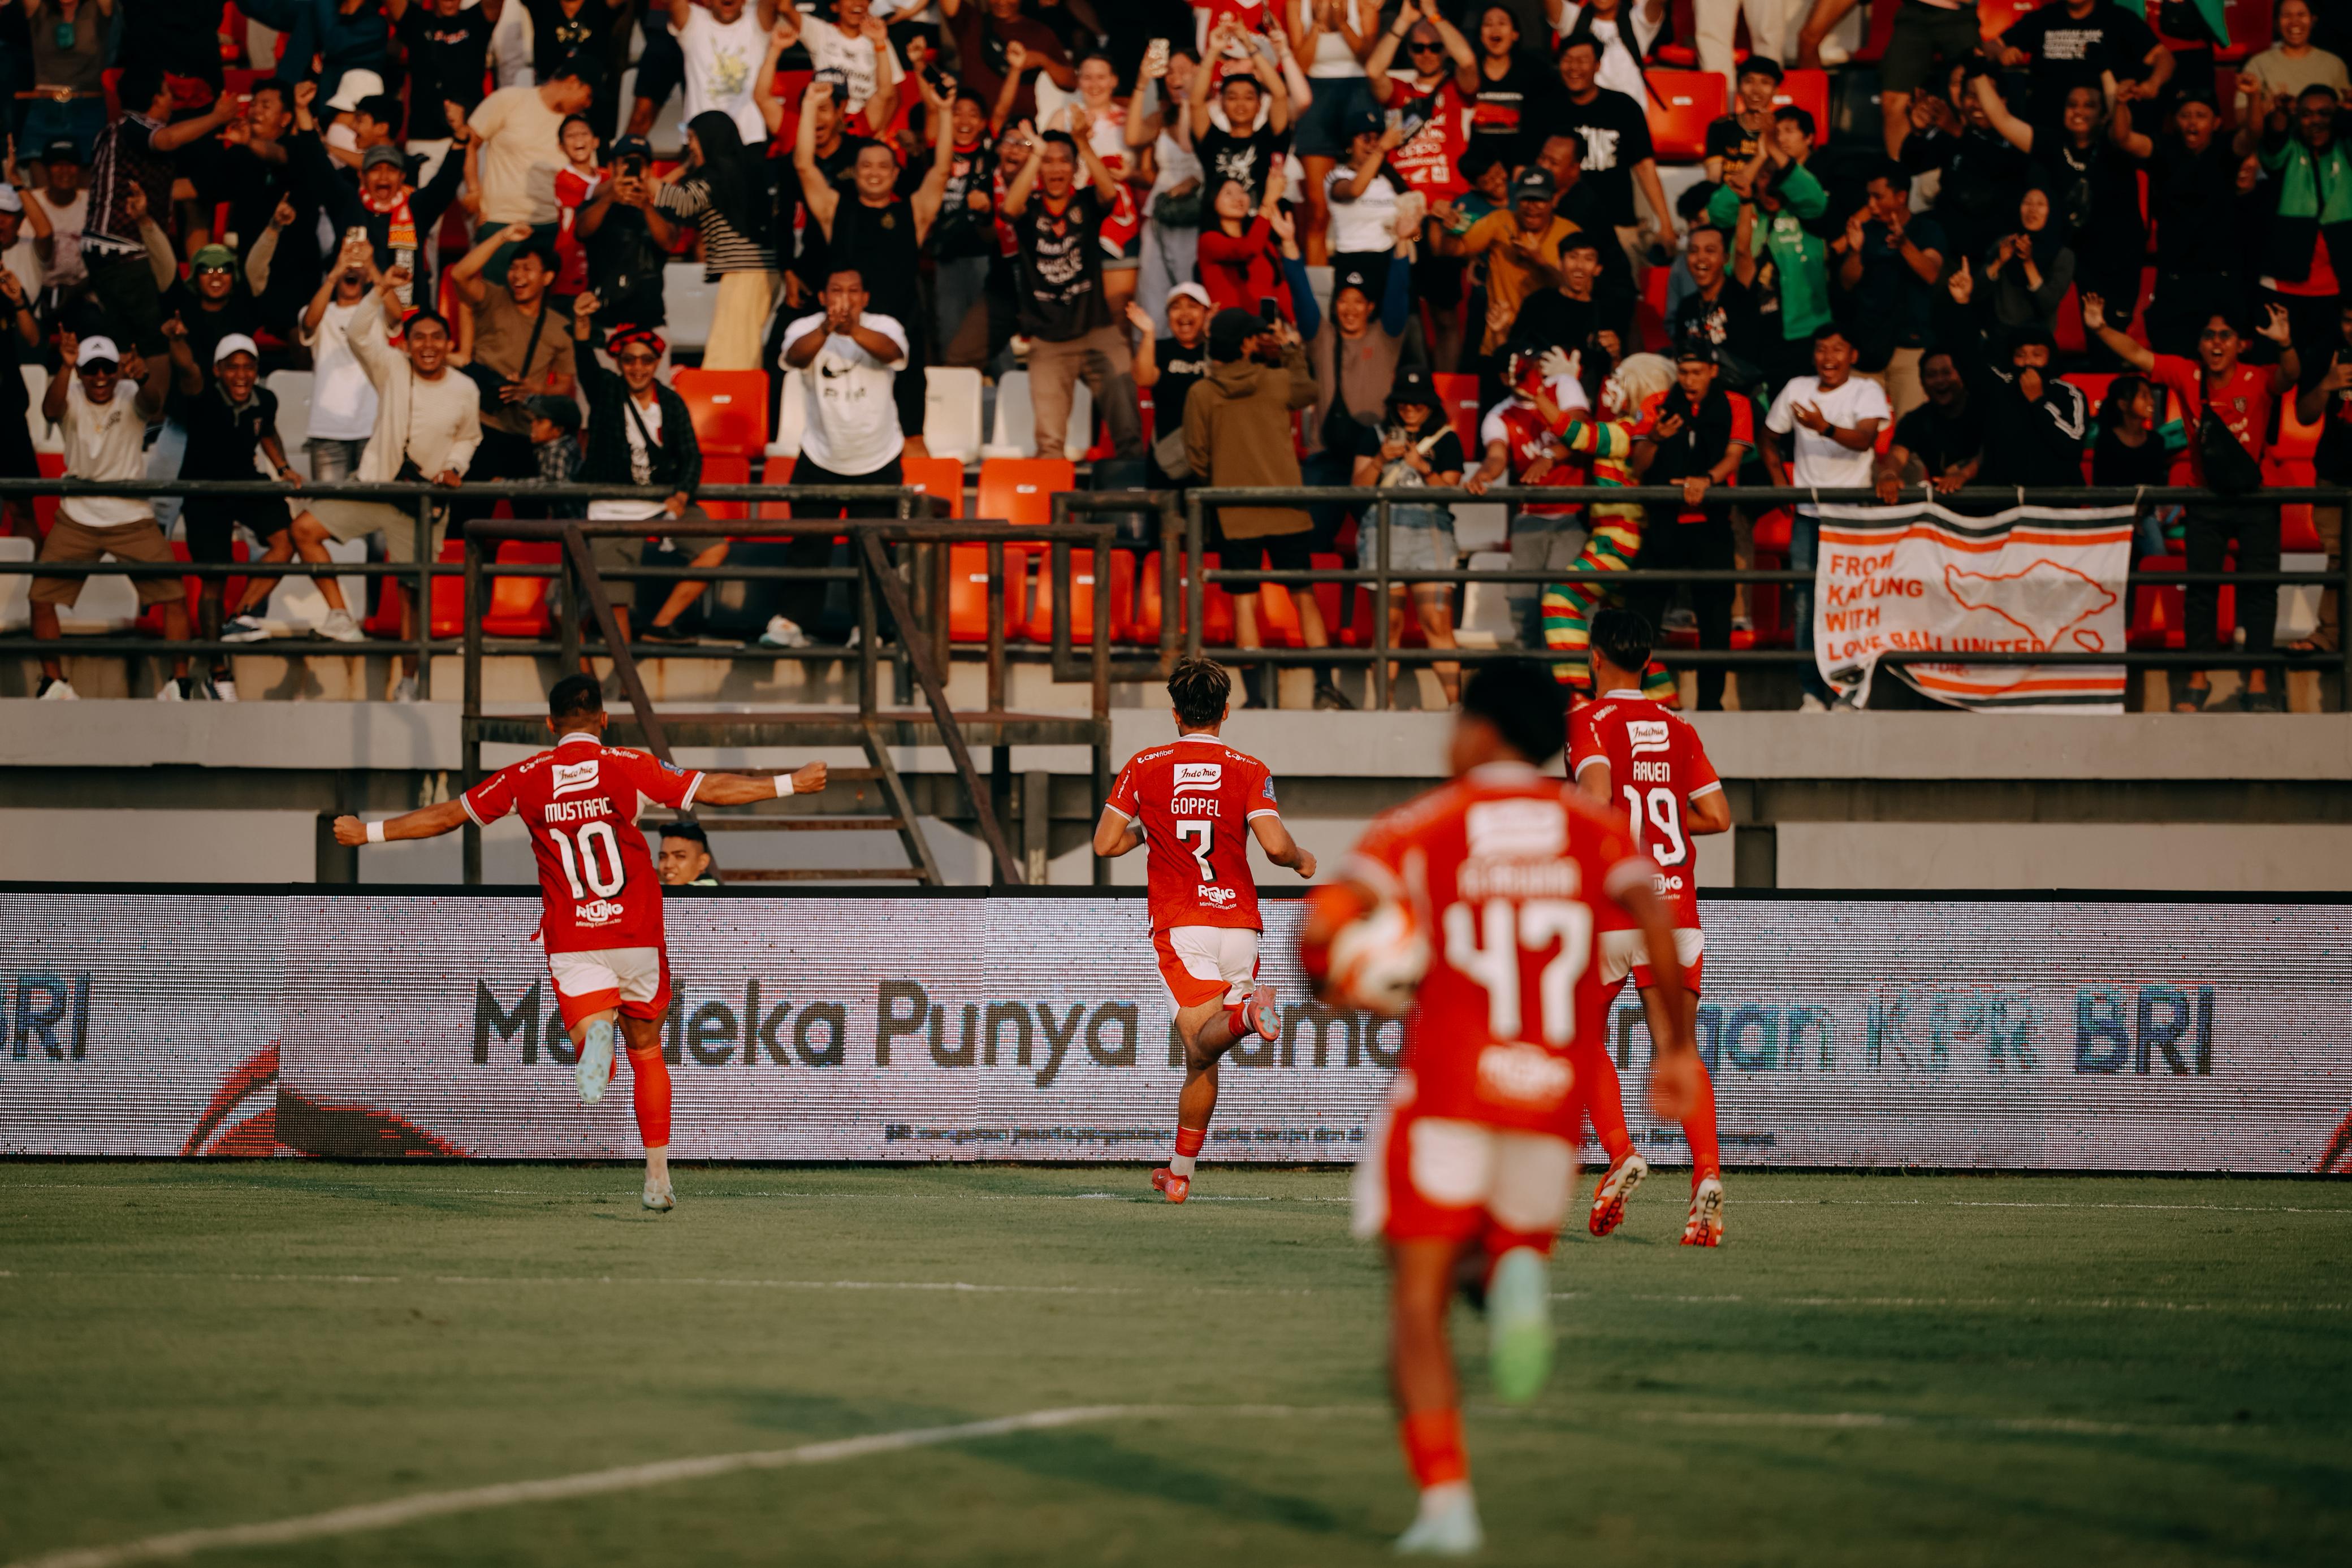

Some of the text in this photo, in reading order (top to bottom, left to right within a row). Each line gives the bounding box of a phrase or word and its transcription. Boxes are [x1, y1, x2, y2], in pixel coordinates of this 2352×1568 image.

[1825, 606, 1880, 633] WITH
[1633, 760, 1671, 782] RAVEN
[544, 796, 613, 824] MUSTAFIC
[1170, 797, 1221, 817] GOPPEL
[1623, 784, 1686, 867] 19
[549, 820, 625, 899] 10
[1176, 820, 1216, 882] 7
[1442, 897, 1594, 1049] 47
[0, 972, 90, 1062] RI
[876, 979, 1138, 1088] Punya
[2075, 982, 2216, 1076] BRI
